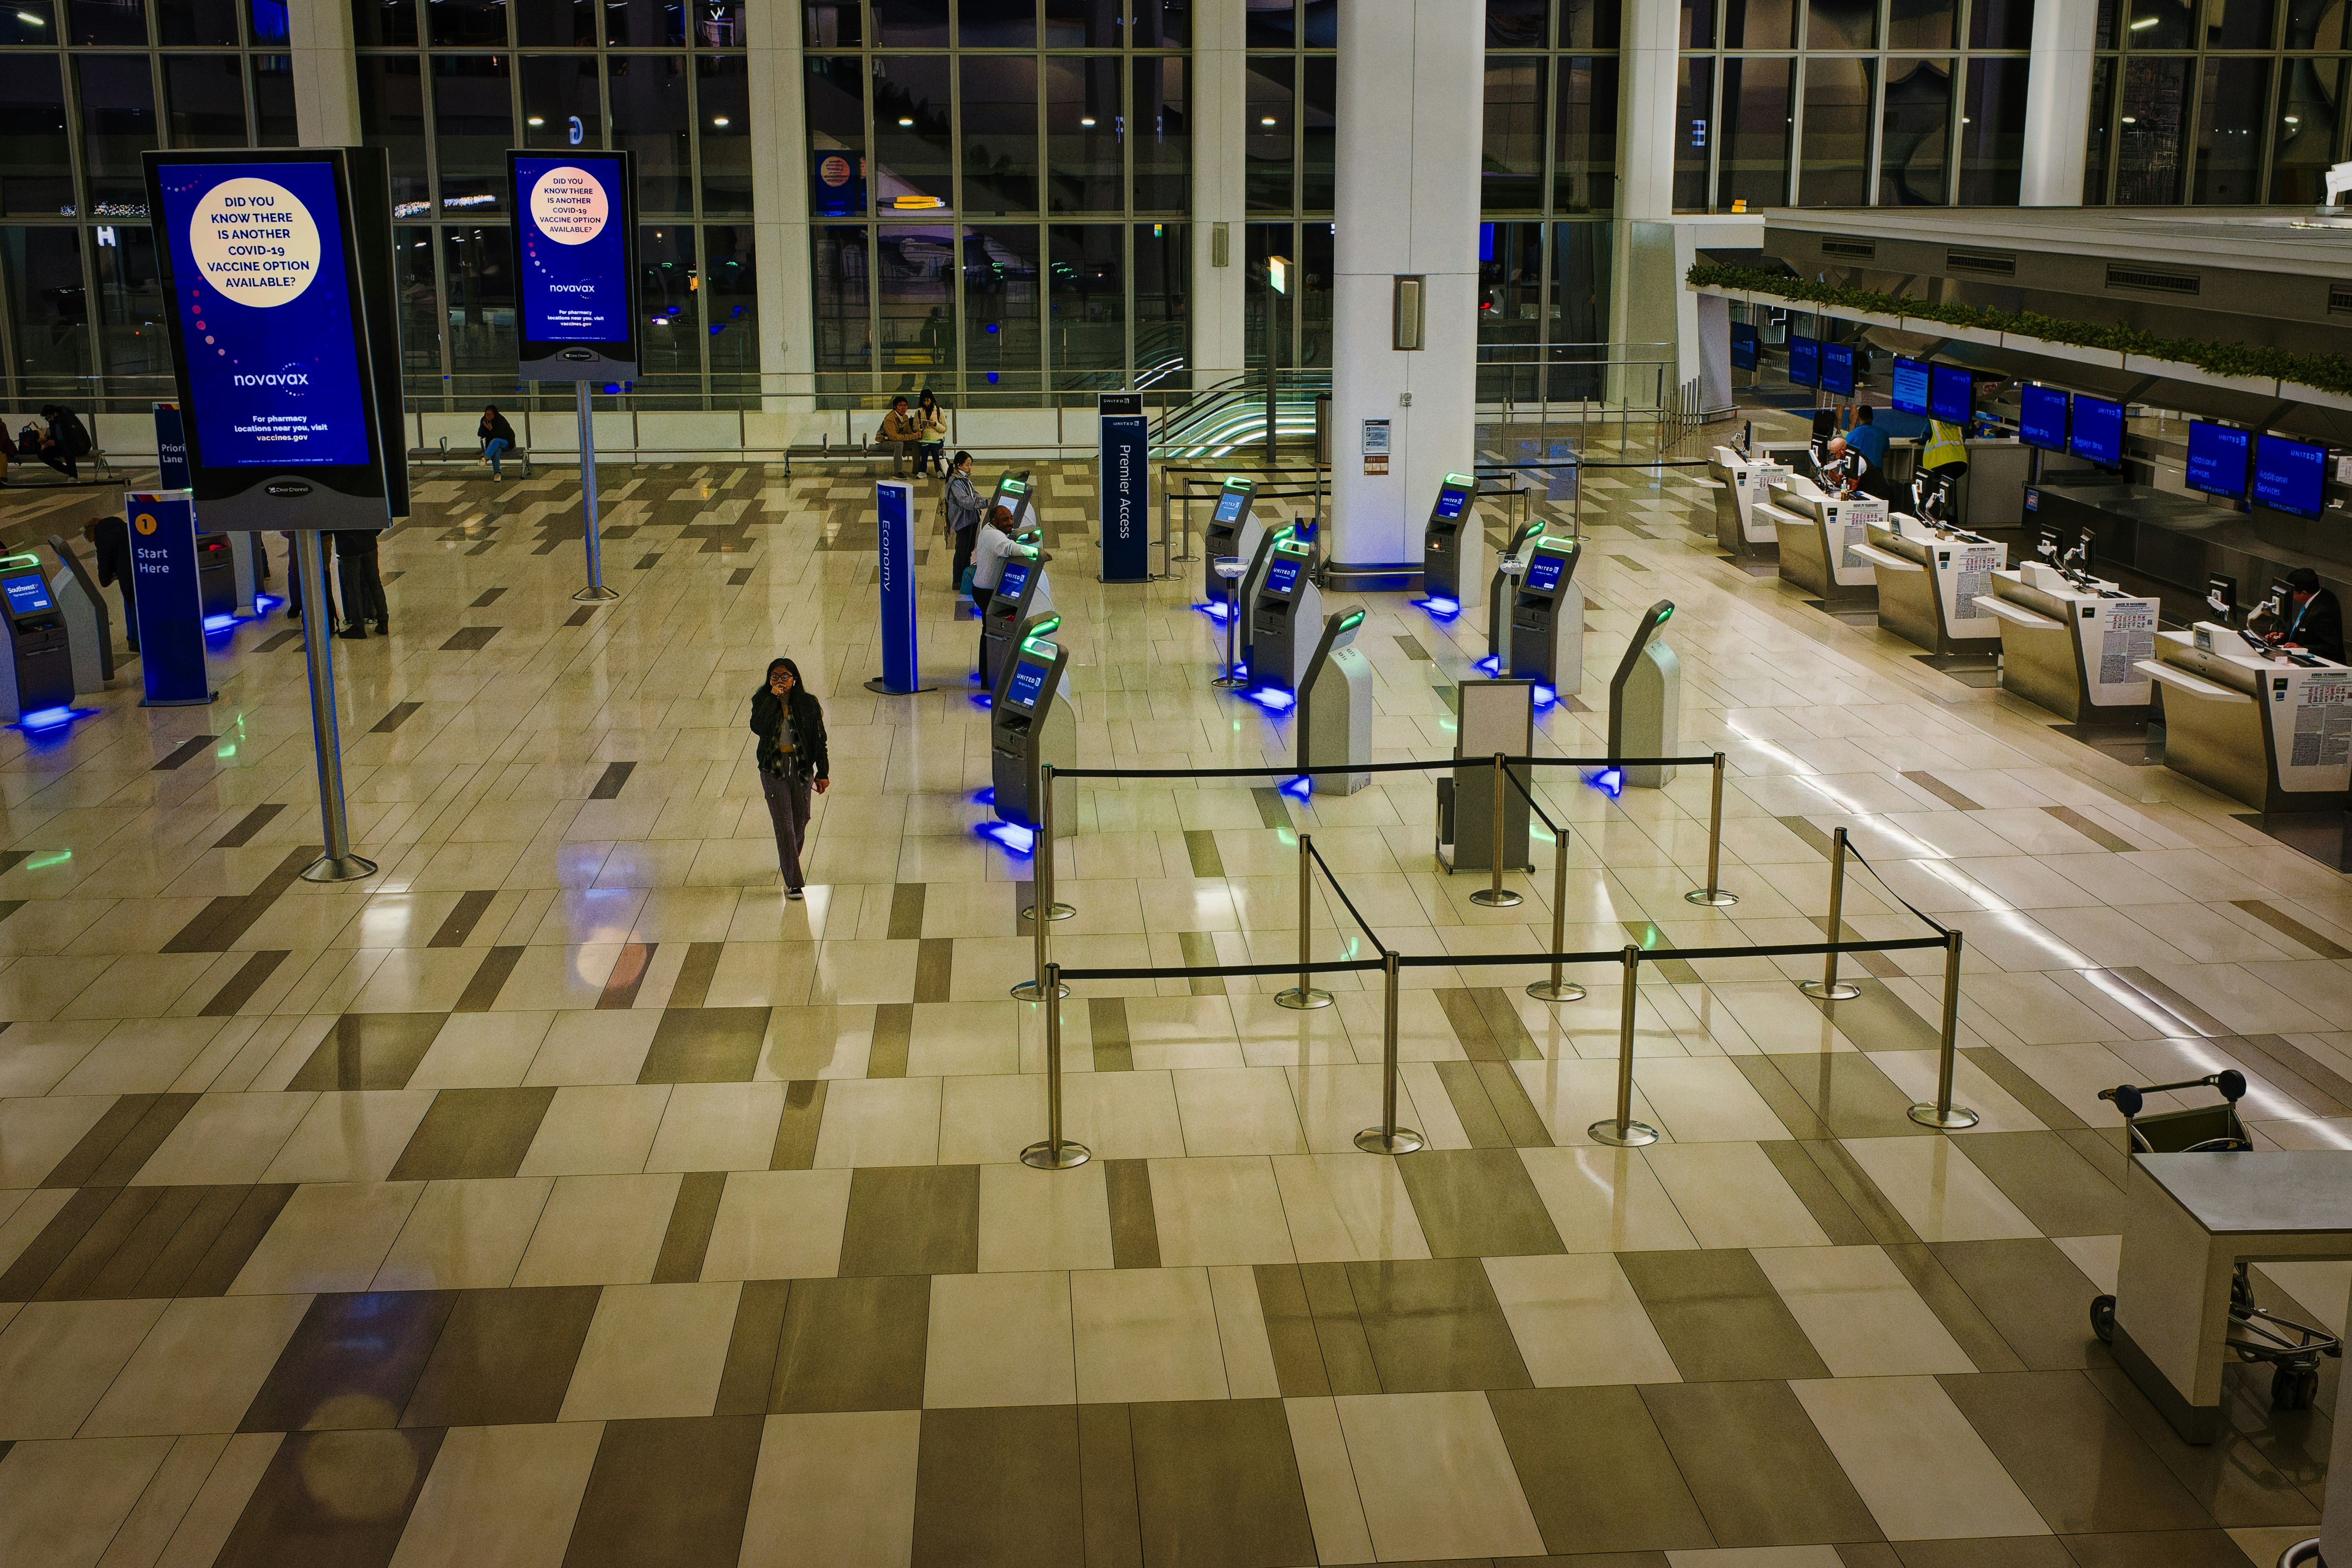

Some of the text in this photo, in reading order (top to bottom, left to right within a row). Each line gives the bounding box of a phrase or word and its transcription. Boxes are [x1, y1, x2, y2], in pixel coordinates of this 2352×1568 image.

[225, 197, 274, 207] DID YOU
[211, 213, 293, 223] KNOW THERE
[218, 229, 291, 239] IS ANOTHER
[228, 246, 284, 256] COVID-19
[207, 261, 309, 272] VACCINE OPTION
[226, 277, 296, 287] AVAILABLE?
[234, 374, 308, 386] novavax
[267, 415, 307, 423] pharmacy
[161, 443, 185, 452] Priori
[2291, 450, 2315, 460] UNITED
[1120, 445, 1131, 538] Premier Access
[142, 519, 147, 529] 1
[138, 548, 168, 558] Start
[139, 563, 169, 573] Here
[7, 584, 36, 594] Southwest
[1017, 673, 1035, 683] UNITED
